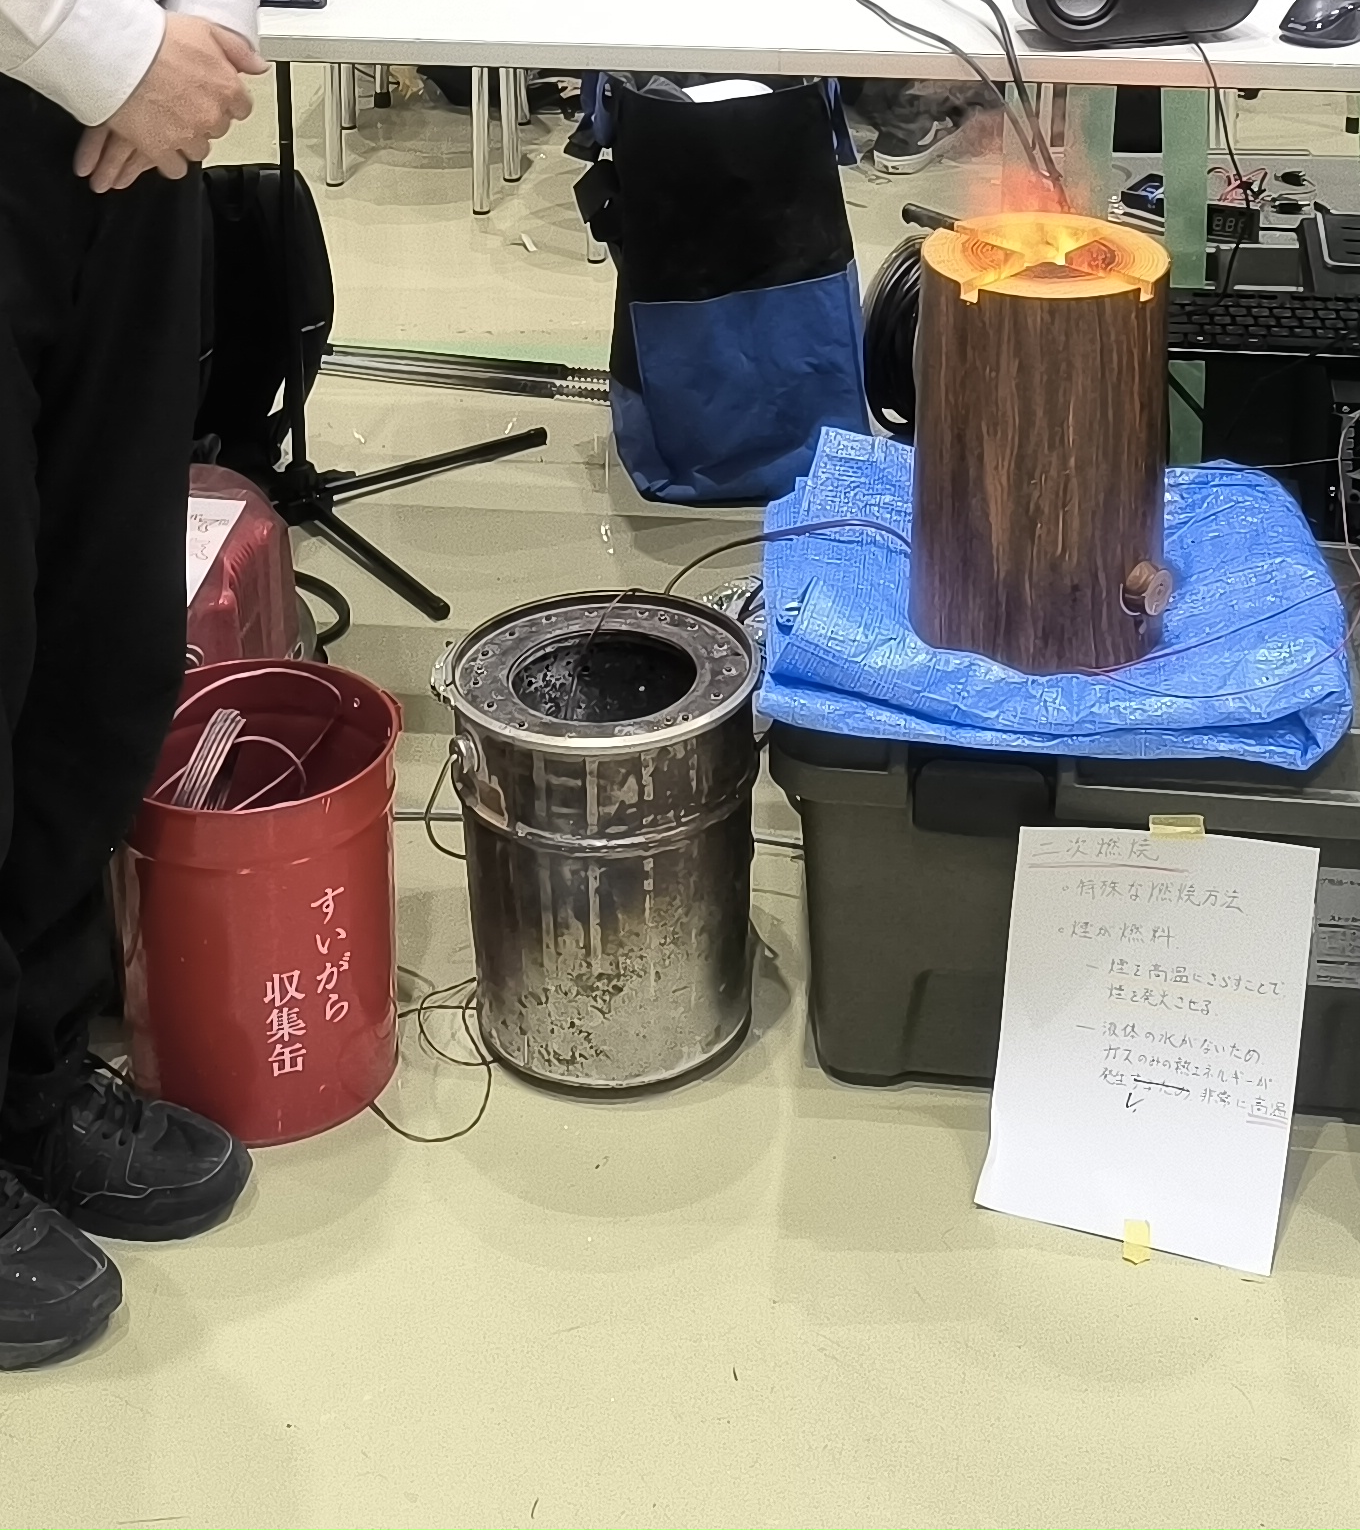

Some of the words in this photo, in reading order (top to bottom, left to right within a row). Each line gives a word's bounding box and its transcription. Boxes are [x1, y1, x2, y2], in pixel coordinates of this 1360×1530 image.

[1032, 837, 1159, 863] 二次燃焼
[1075, 878, 1245, 914] 特殊な燃焼方法
[310, 886, 351, 1023] すいがら
[1107, 957, 1286, 998] 煙を高温にさらすことで
[263, 969, 307, 1078] 収集缶
